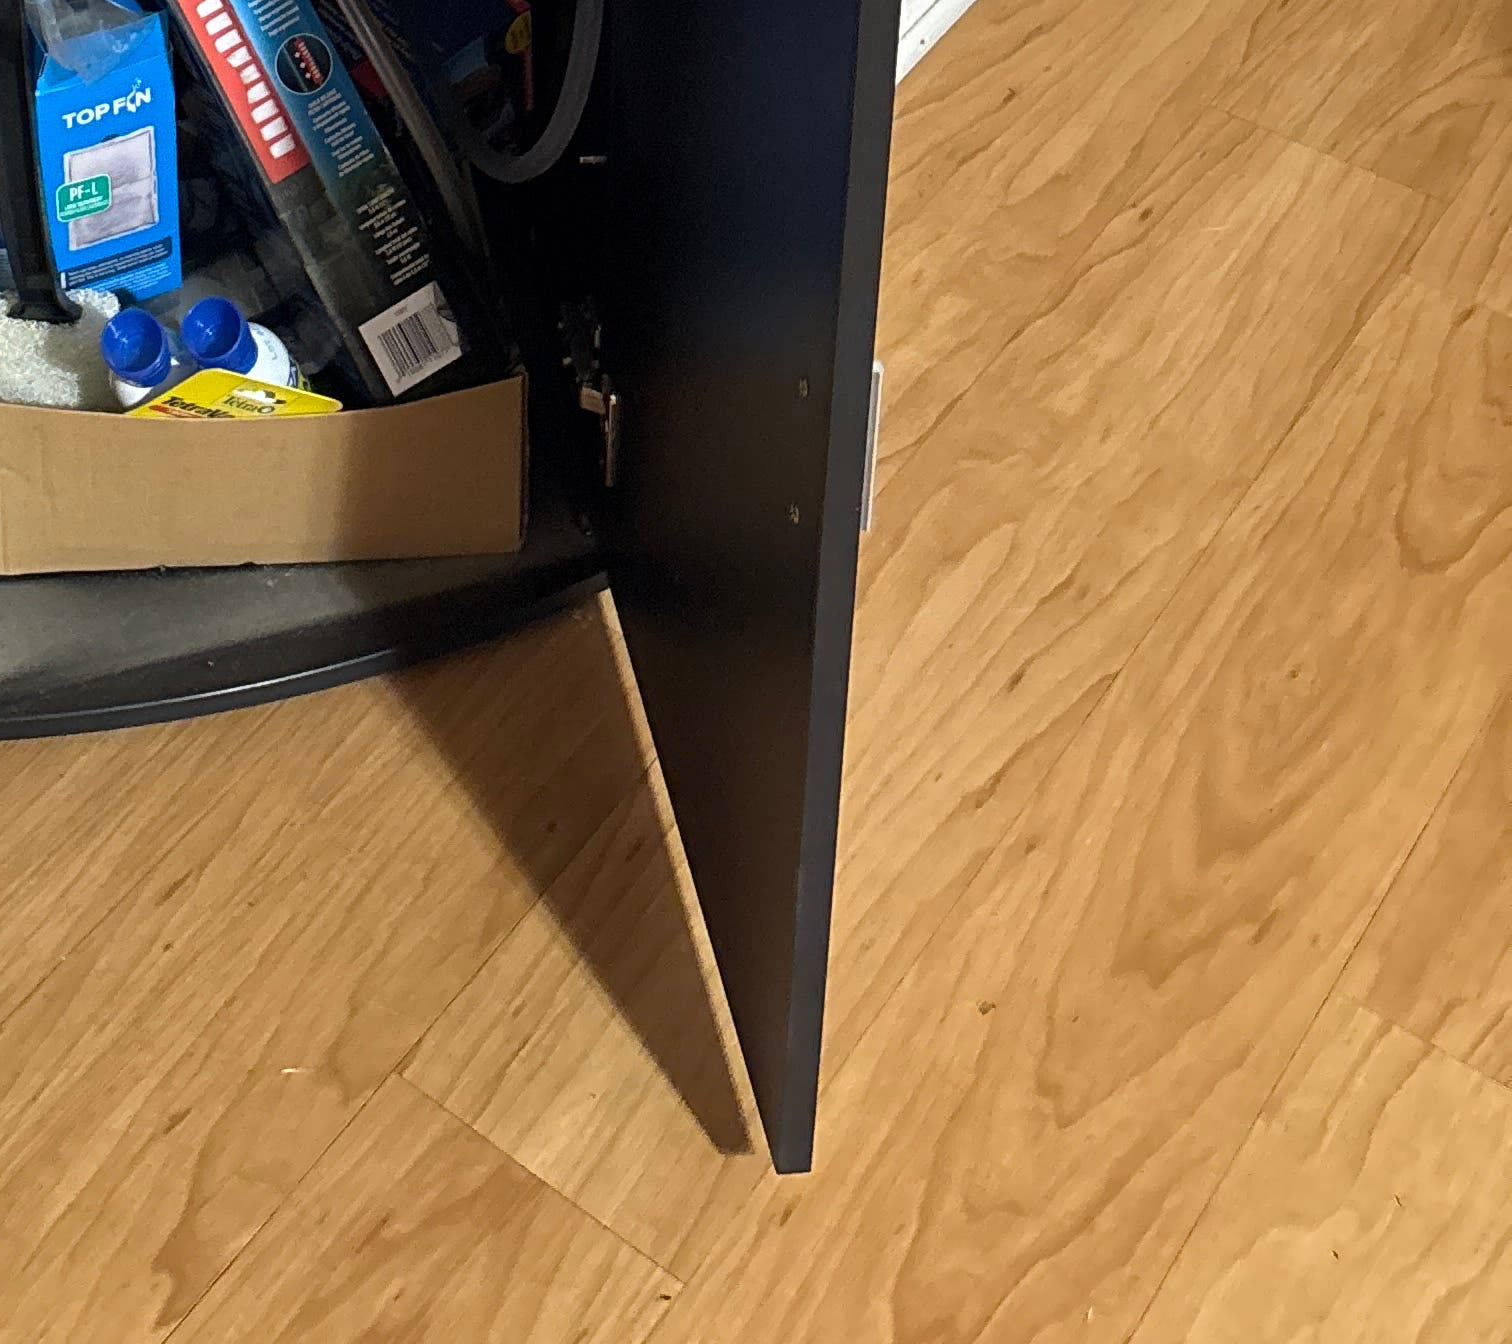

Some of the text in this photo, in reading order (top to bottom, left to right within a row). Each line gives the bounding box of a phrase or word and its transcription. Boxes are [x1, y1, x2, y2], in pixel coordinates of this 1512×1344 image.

[62, 84, 152, 129] TOP FIN
[69, 181, 99, 202] PF-L
